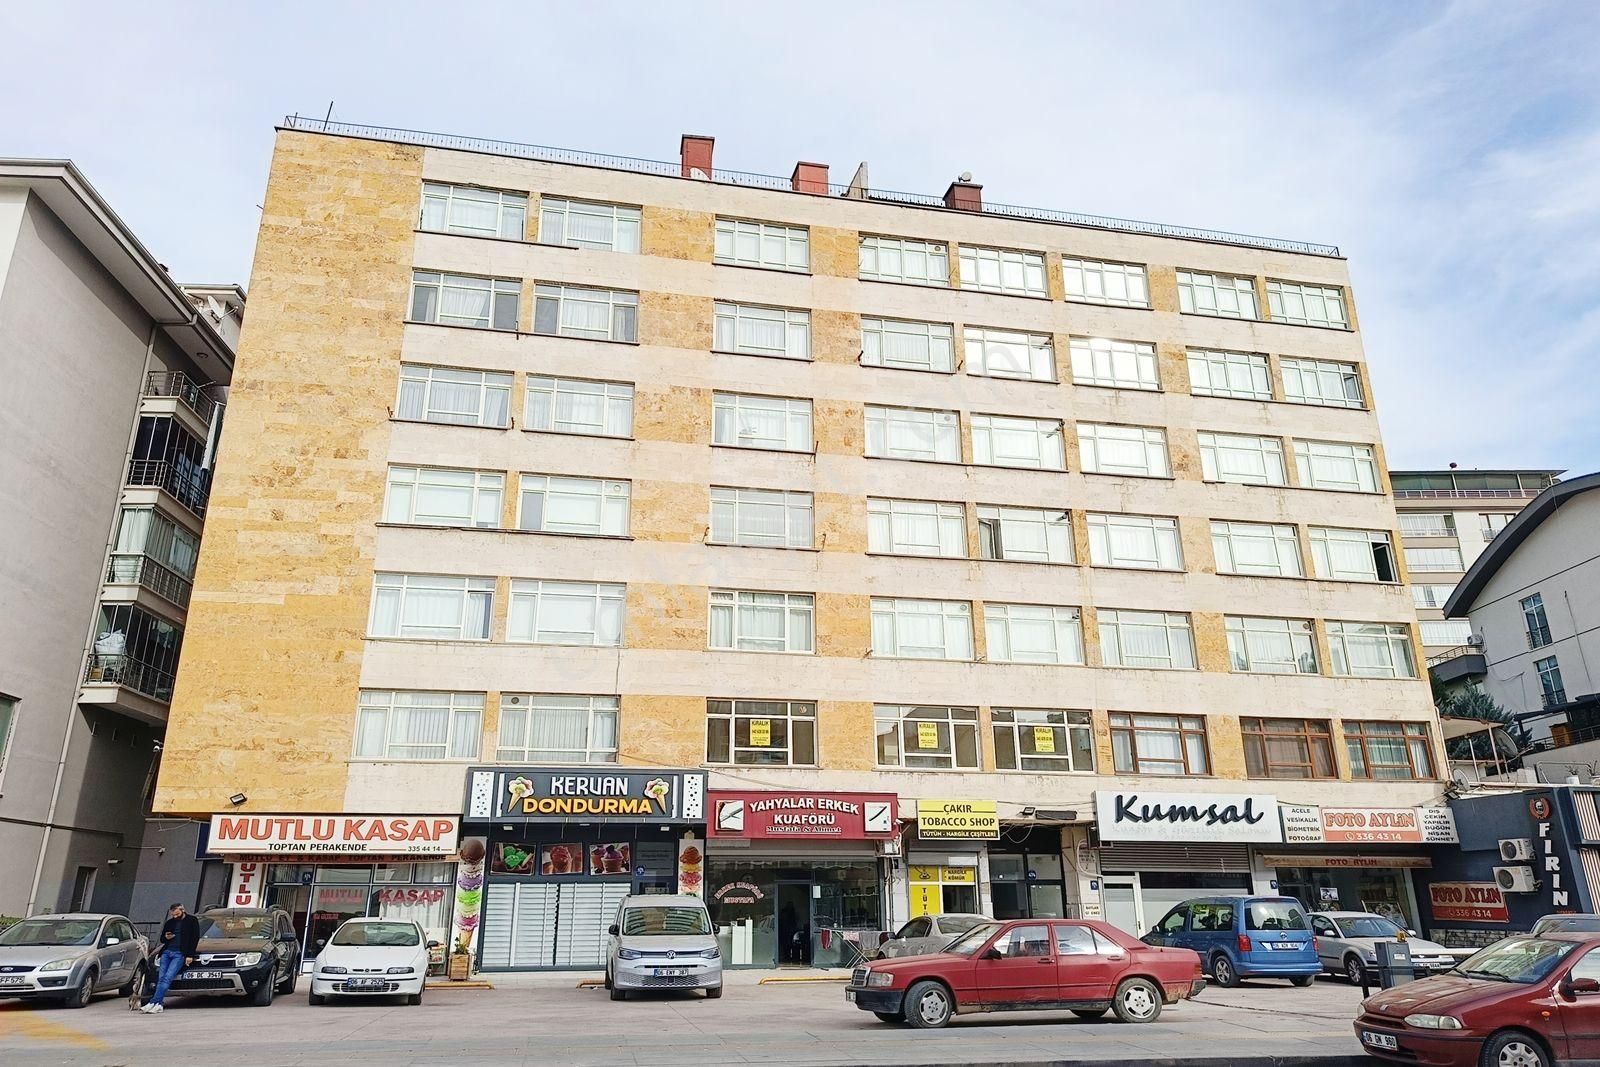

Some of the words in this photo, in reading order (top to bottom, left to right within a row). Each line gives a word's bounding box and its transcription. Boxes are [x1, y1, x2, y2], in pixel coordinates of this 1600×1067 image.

[522, 798, 652, 814] DONDURMA
[750, 798, 814, 812] YAHYALAR
[818, 798, 860, 814] ERKEK
[944, 804, 972, 815] ÇAKIR
[1114, 794, 1264, 826] Kumsal
[774, 812, 836, 824] KUAFÖRÜ
[921, 817, 966, 826] TOBACCO
[970, 818, 995, 826] SHOP
[1324, 813, 1366, 827] FOTO
[218, 818, 335, 840] MUTLU
[343, 819, 453, 841] KASAP
[268, 843, 306, 851] TOPTAN
[310, 843, 367, 851] PERAKENDE
[1539, 822, 1568, 906] FIRIN
[236, 863, 256, 905] UTLU
[378, 889, 444, 902] KASAP
[1431, 887, 1462, 902] FOTO
